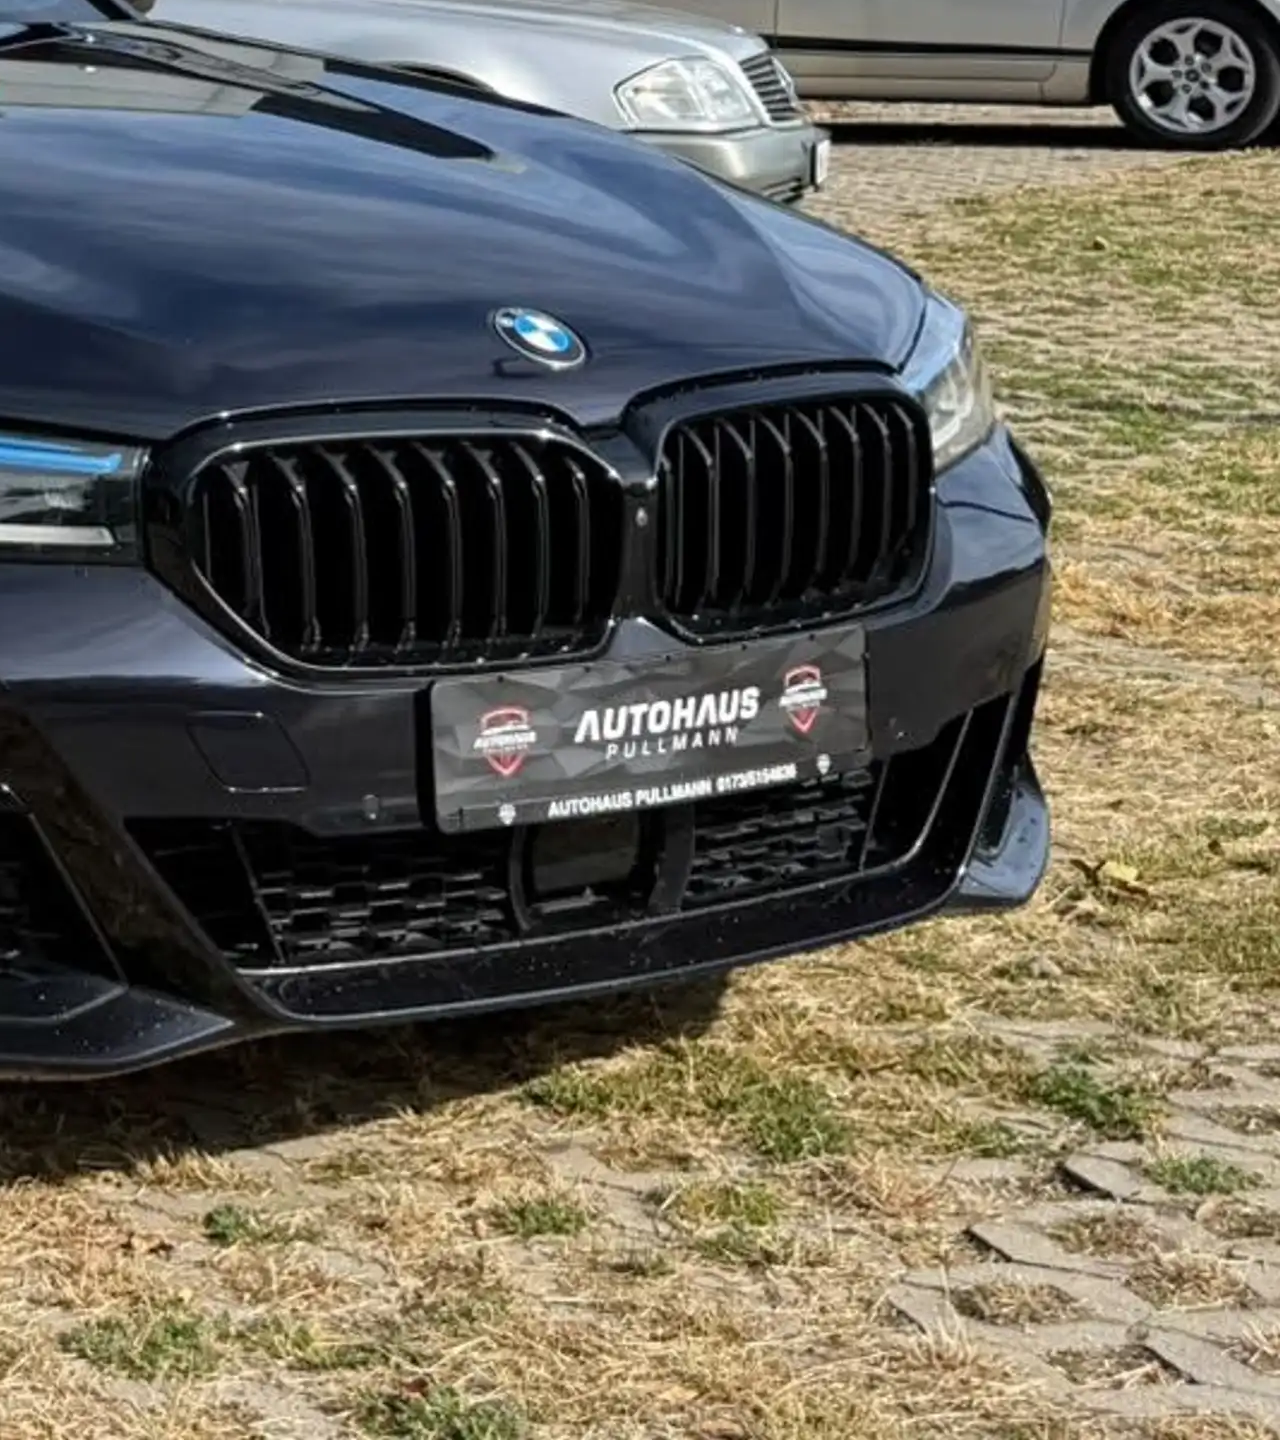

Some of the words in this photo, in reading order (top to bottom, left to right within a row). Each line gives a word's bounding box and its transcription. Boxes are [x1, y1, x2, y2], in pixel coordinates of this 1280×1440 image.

[573, 686, 760, 744] AUTOHAUS
[605, 726, 739, 760] PULLMANN
[547, 791, 633, 819] AUTOHAUS
[635, 776, 713, 806] PULLMANN
